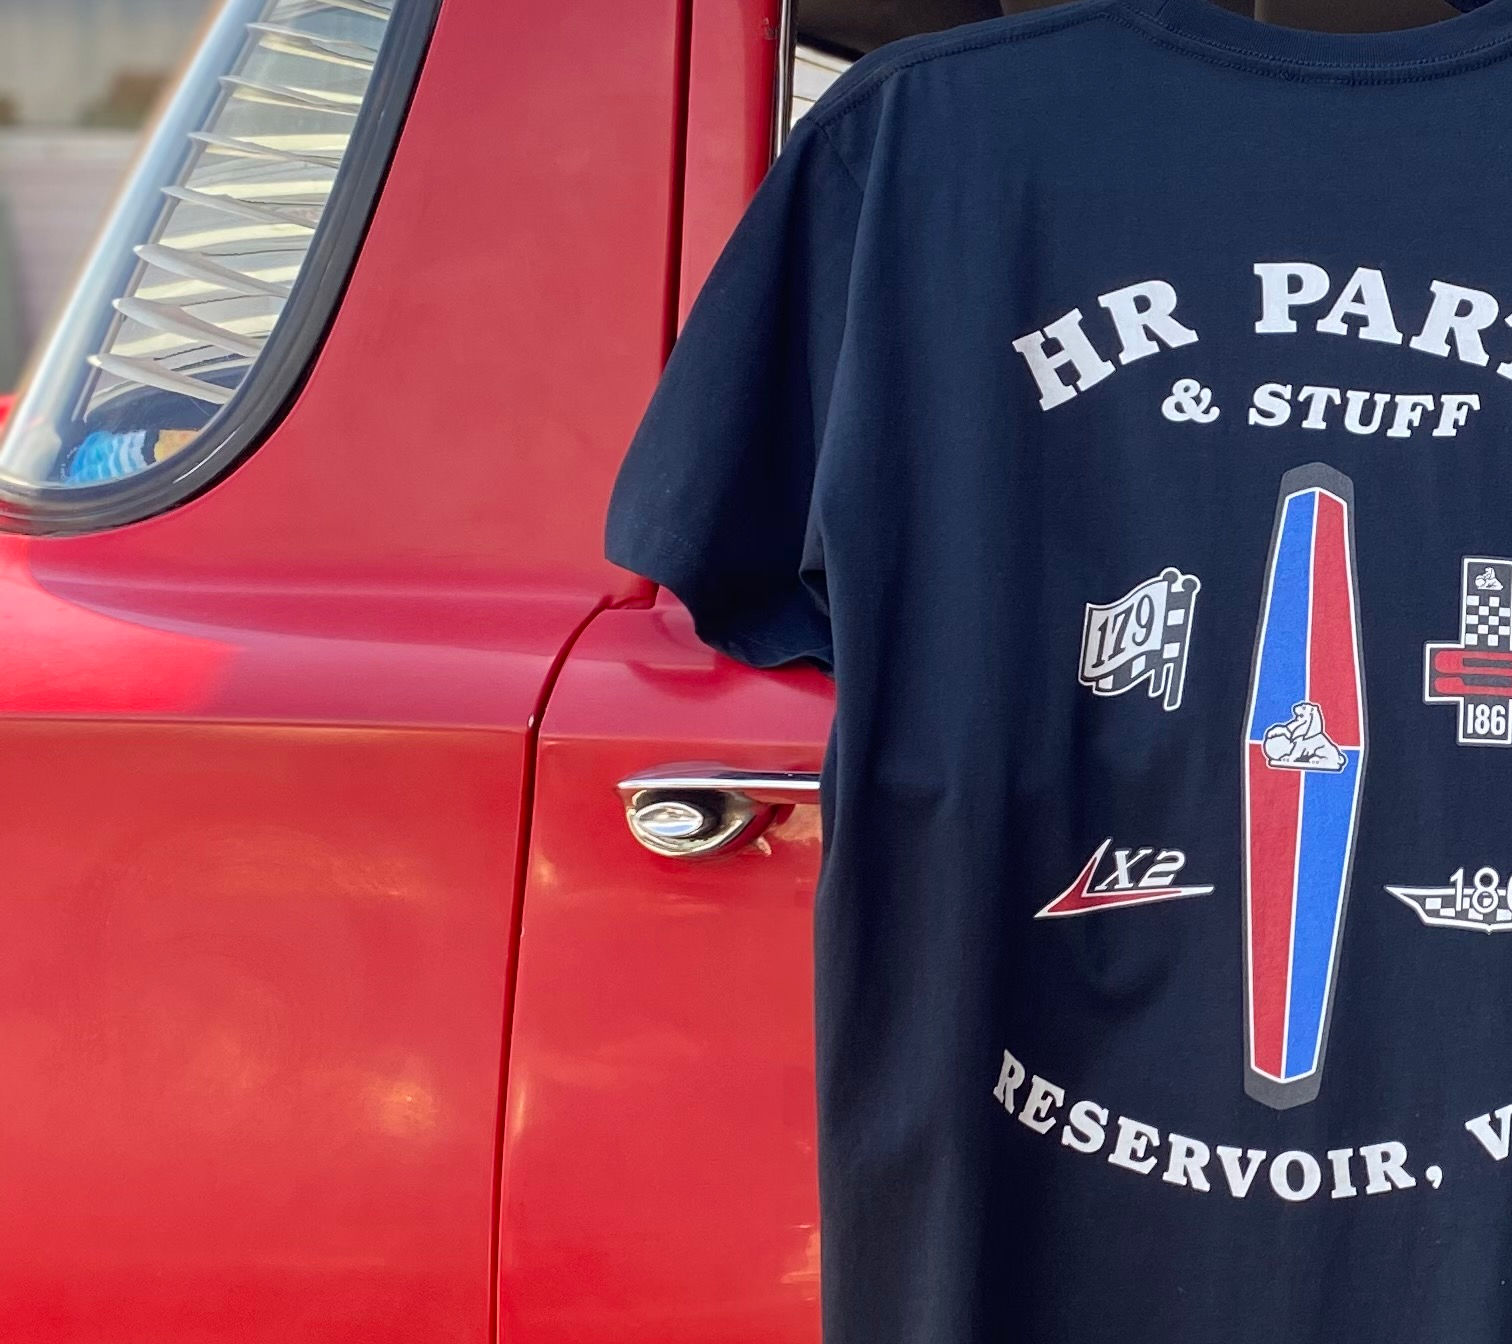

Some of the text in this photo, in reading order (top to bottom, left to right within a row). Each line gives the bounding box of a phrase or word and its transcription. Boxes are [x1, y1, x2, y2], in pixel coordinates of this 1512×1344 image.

[1012, 279, 1199, 412] HR
[1160, 377, 1481, 439] & STUFF
[1090, 593, 1156, 669] 179
[1466, 703, 1507, 736] 186
[1094, 848, 1187, 892] X2
[992, 1049, 1444, 1202] RESERVOIR,
